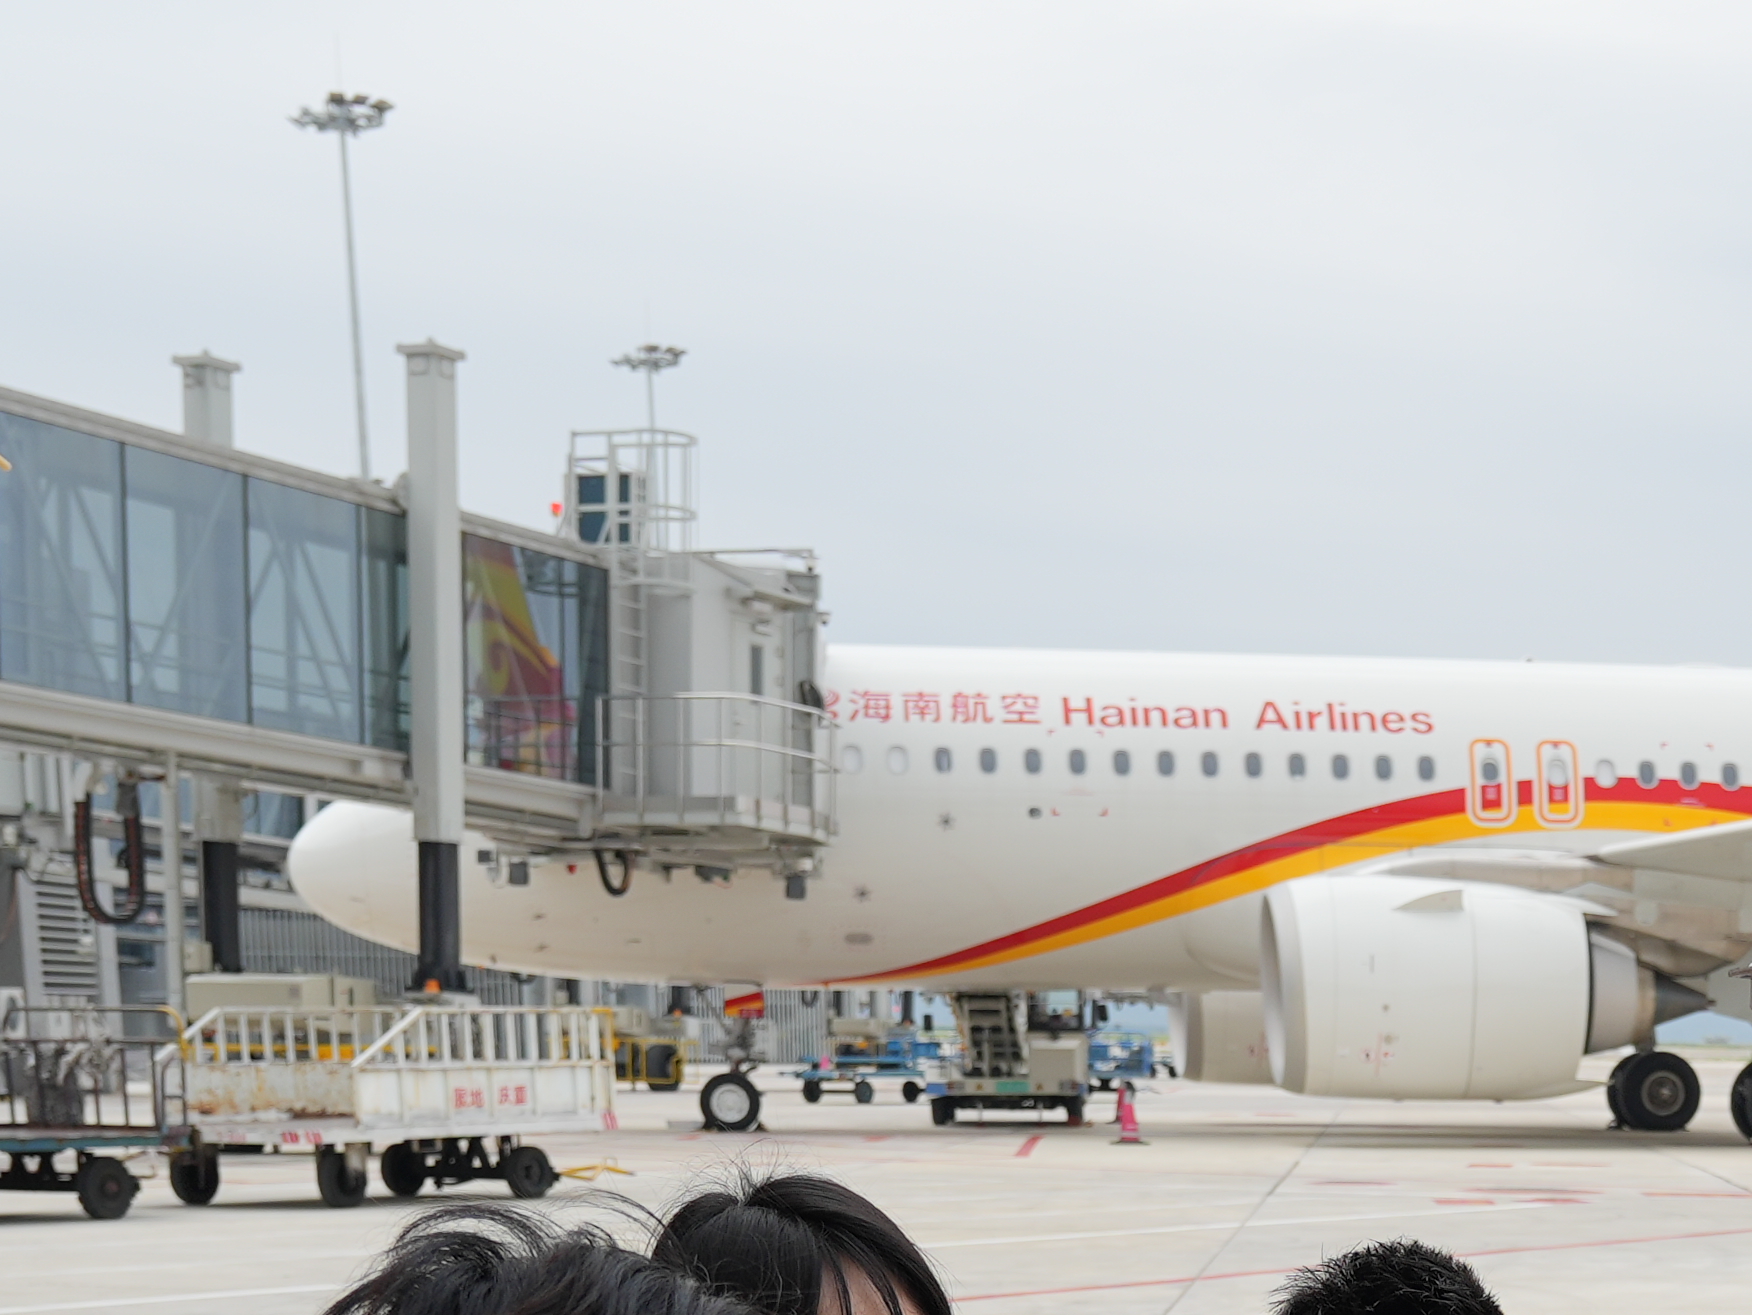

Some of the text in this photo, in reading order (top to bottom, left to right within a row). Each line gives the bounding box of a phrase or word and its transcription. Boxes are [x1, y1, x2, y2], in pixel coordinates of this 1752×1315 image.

[849, 690, 1435, 734] 海南航空 Hainan Airlines
